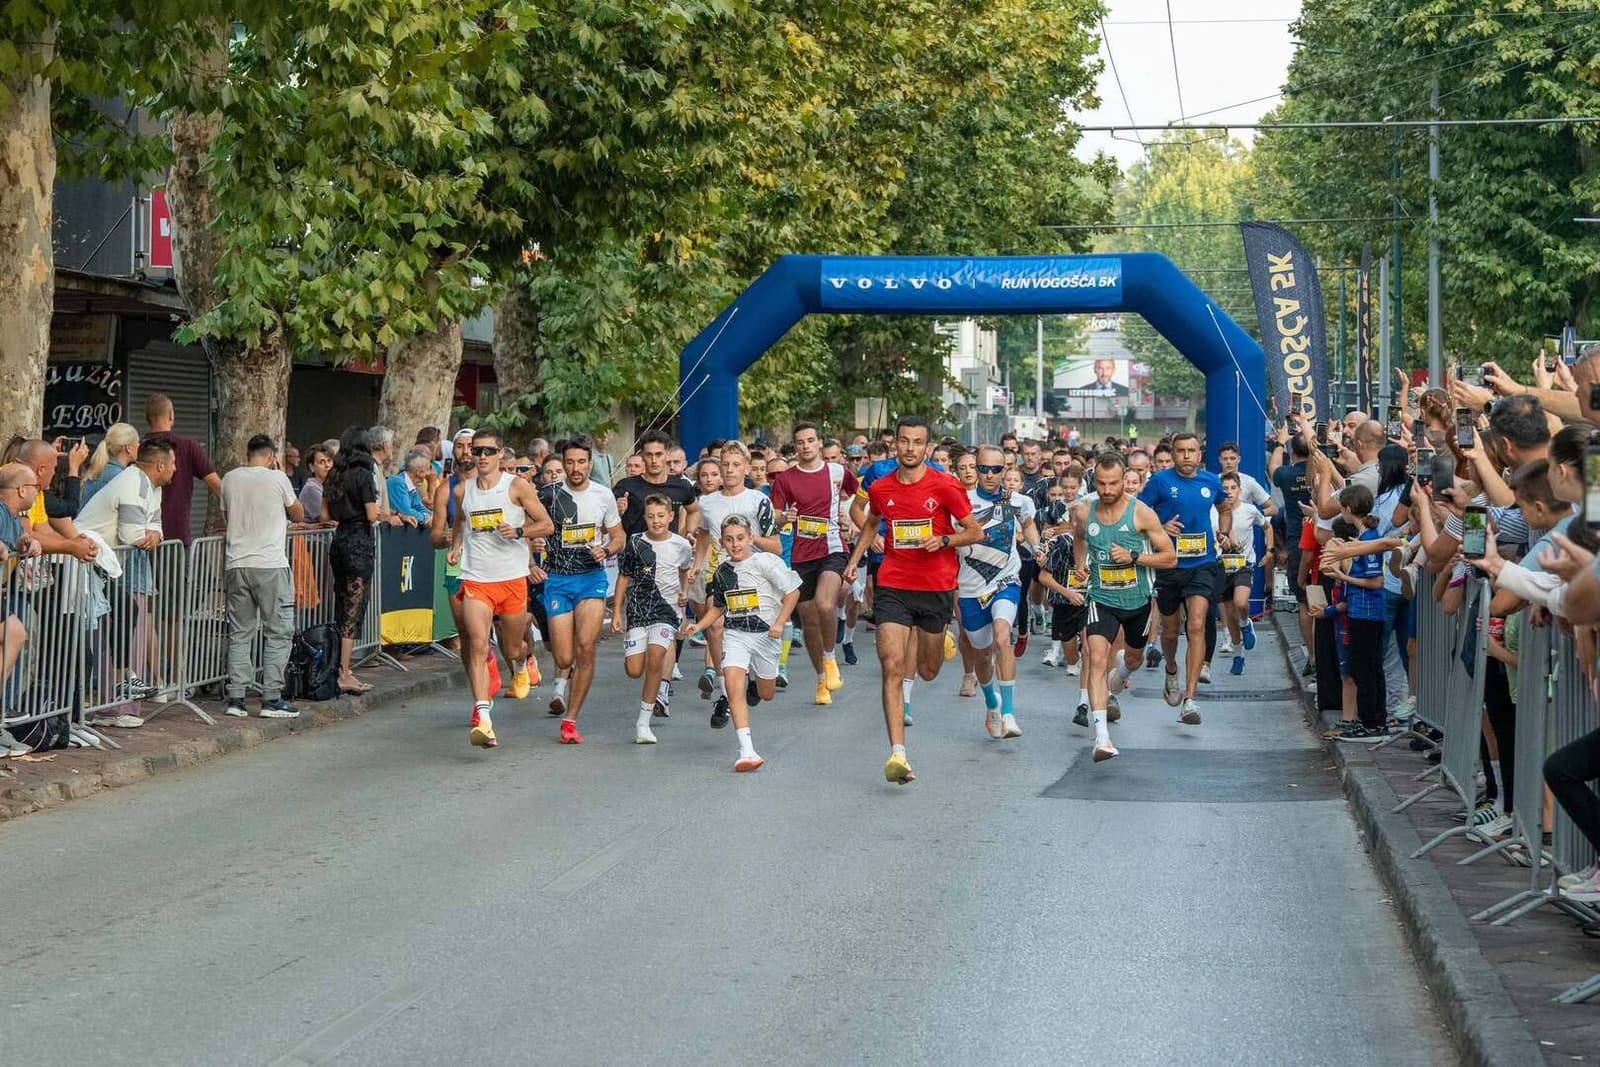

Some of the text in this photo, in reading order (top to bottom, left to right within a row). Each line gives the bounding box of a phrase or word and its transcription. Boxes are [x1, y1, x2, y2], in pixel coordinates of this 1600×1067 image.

[829, 278, 952, 289] VOLVO
[1001, 278, 1030, 289] RUN
[1098, 276, 1117, 287] 5K
